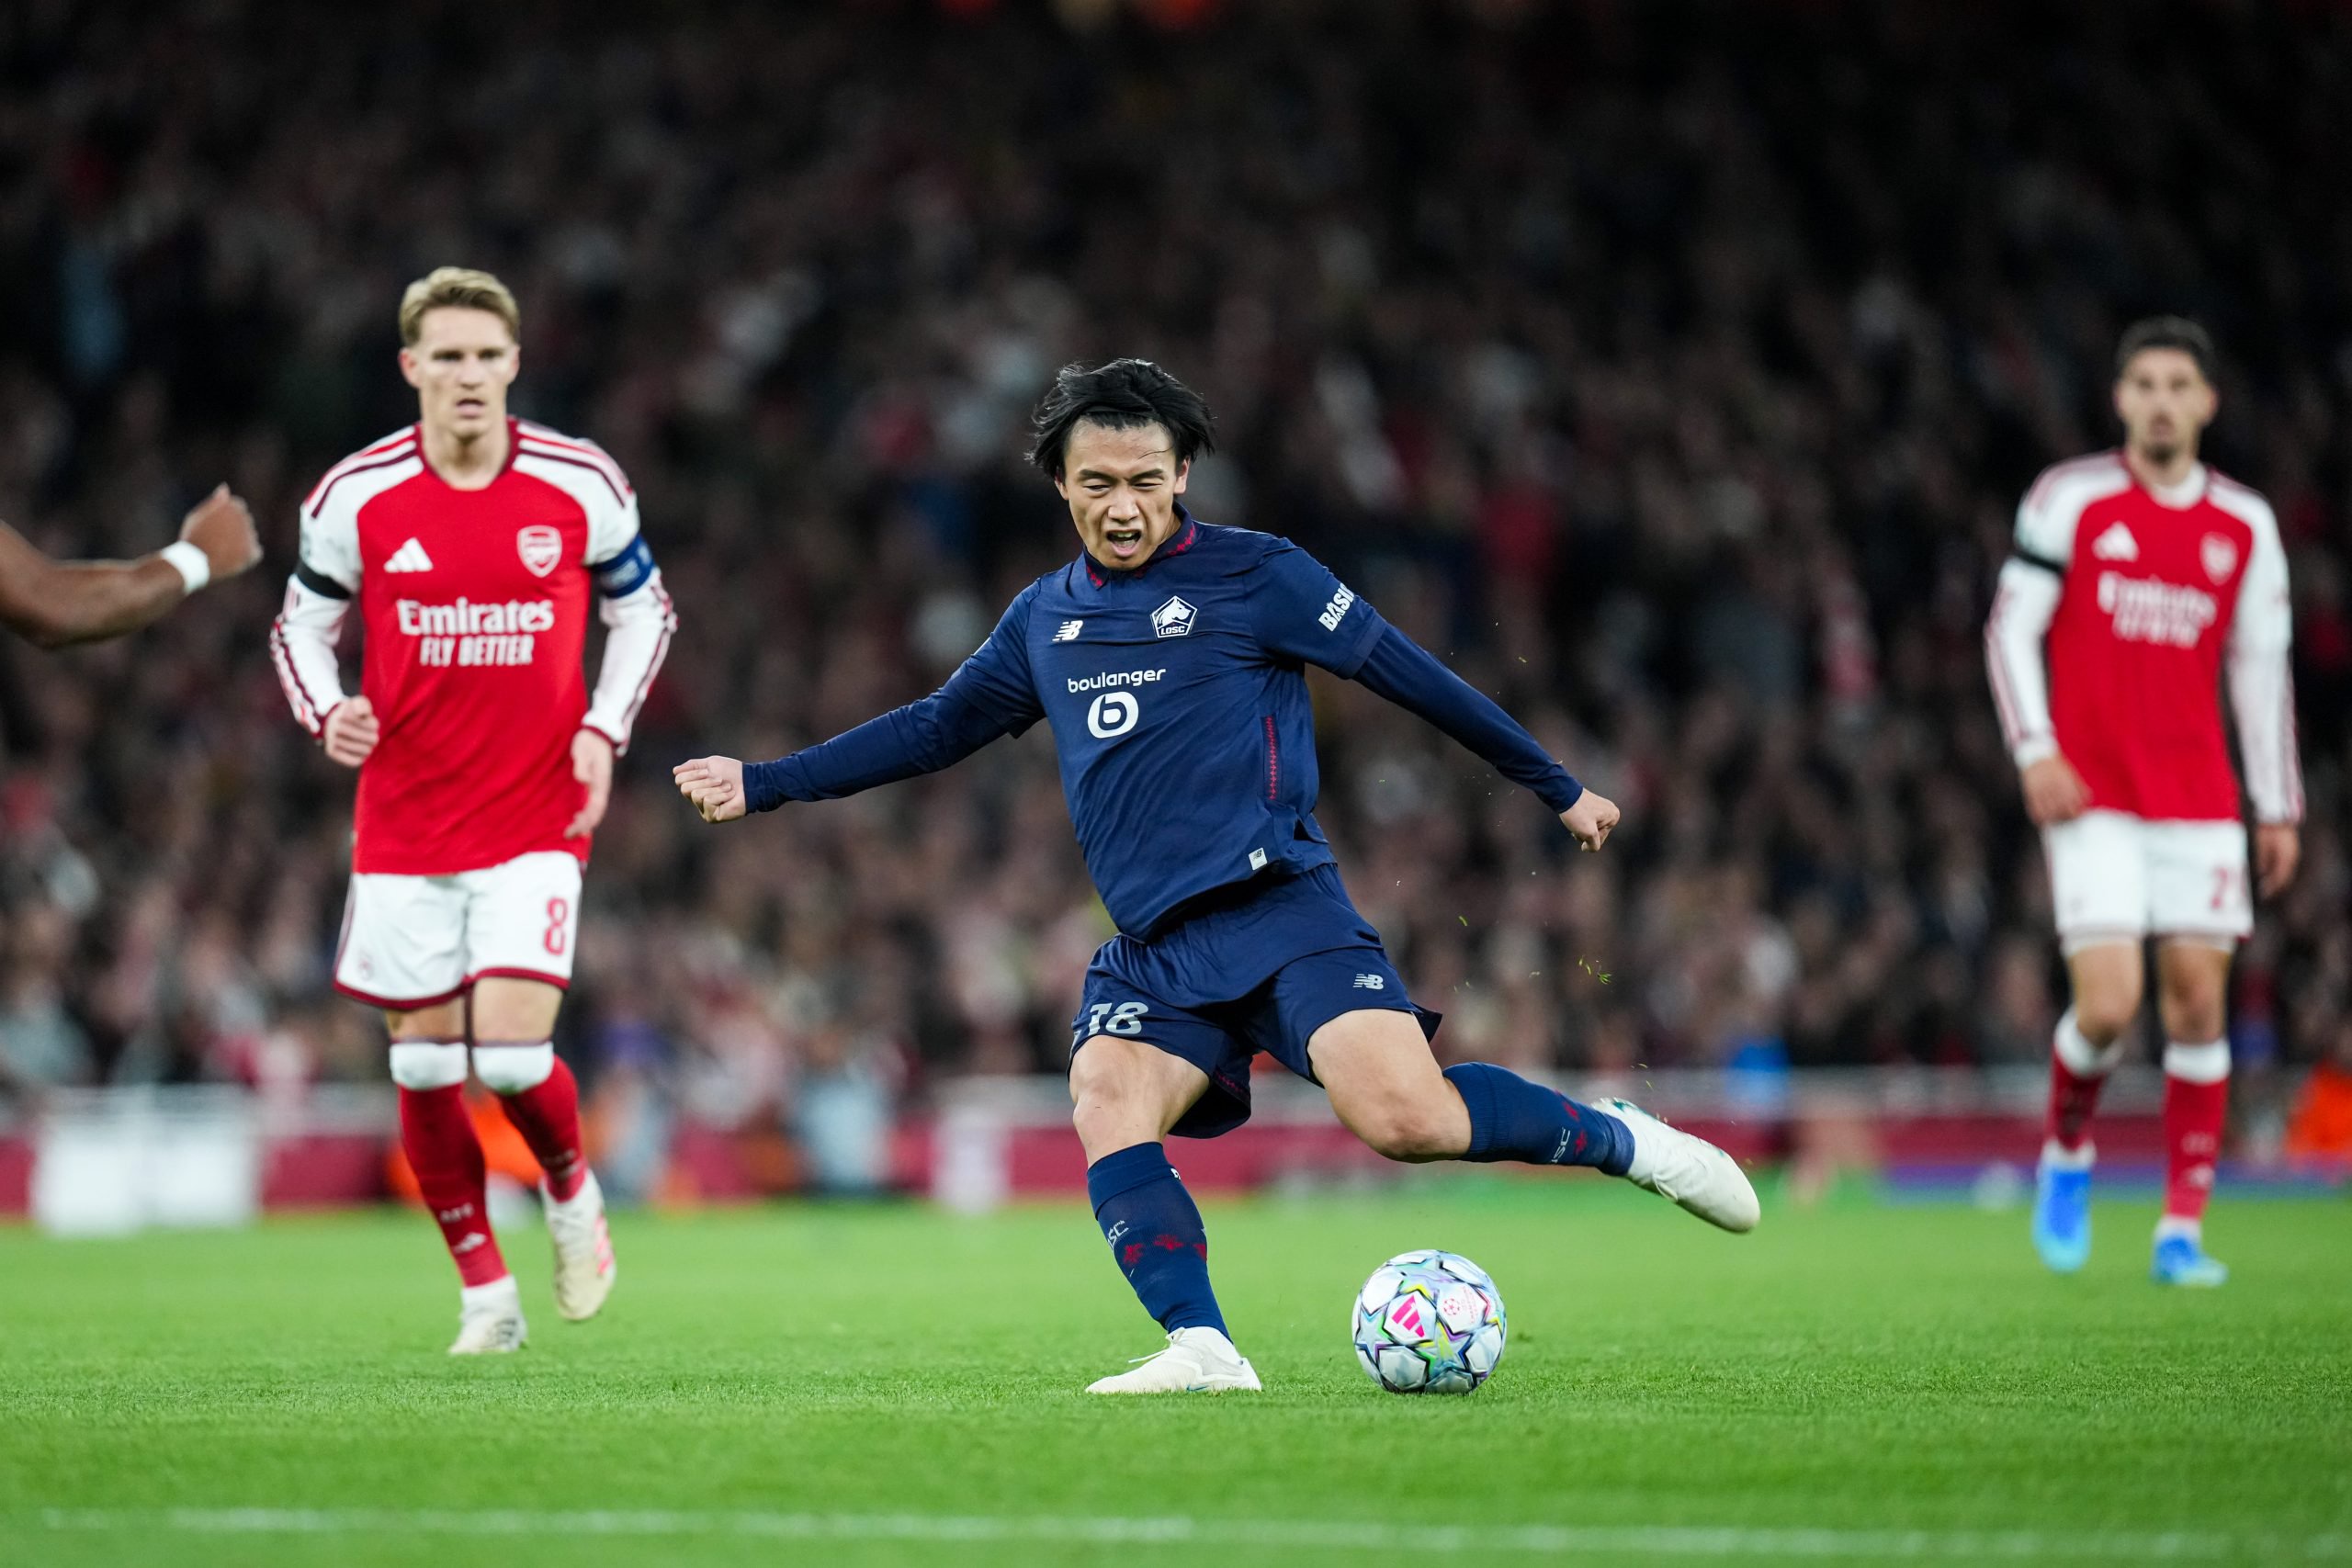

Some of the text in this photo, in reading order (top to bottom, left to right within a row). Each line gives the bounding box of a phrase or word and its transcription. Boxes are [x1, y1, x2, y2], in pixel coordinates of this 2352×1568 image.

[396, 596, 554, 636] Emirates
[1160, 626, 1185, 636] LOSC
[420, 633, 535, 667] FLY BETTER
[1068, 669, 1166, 693] boulanger
[544, 897, 568, 955] 8
